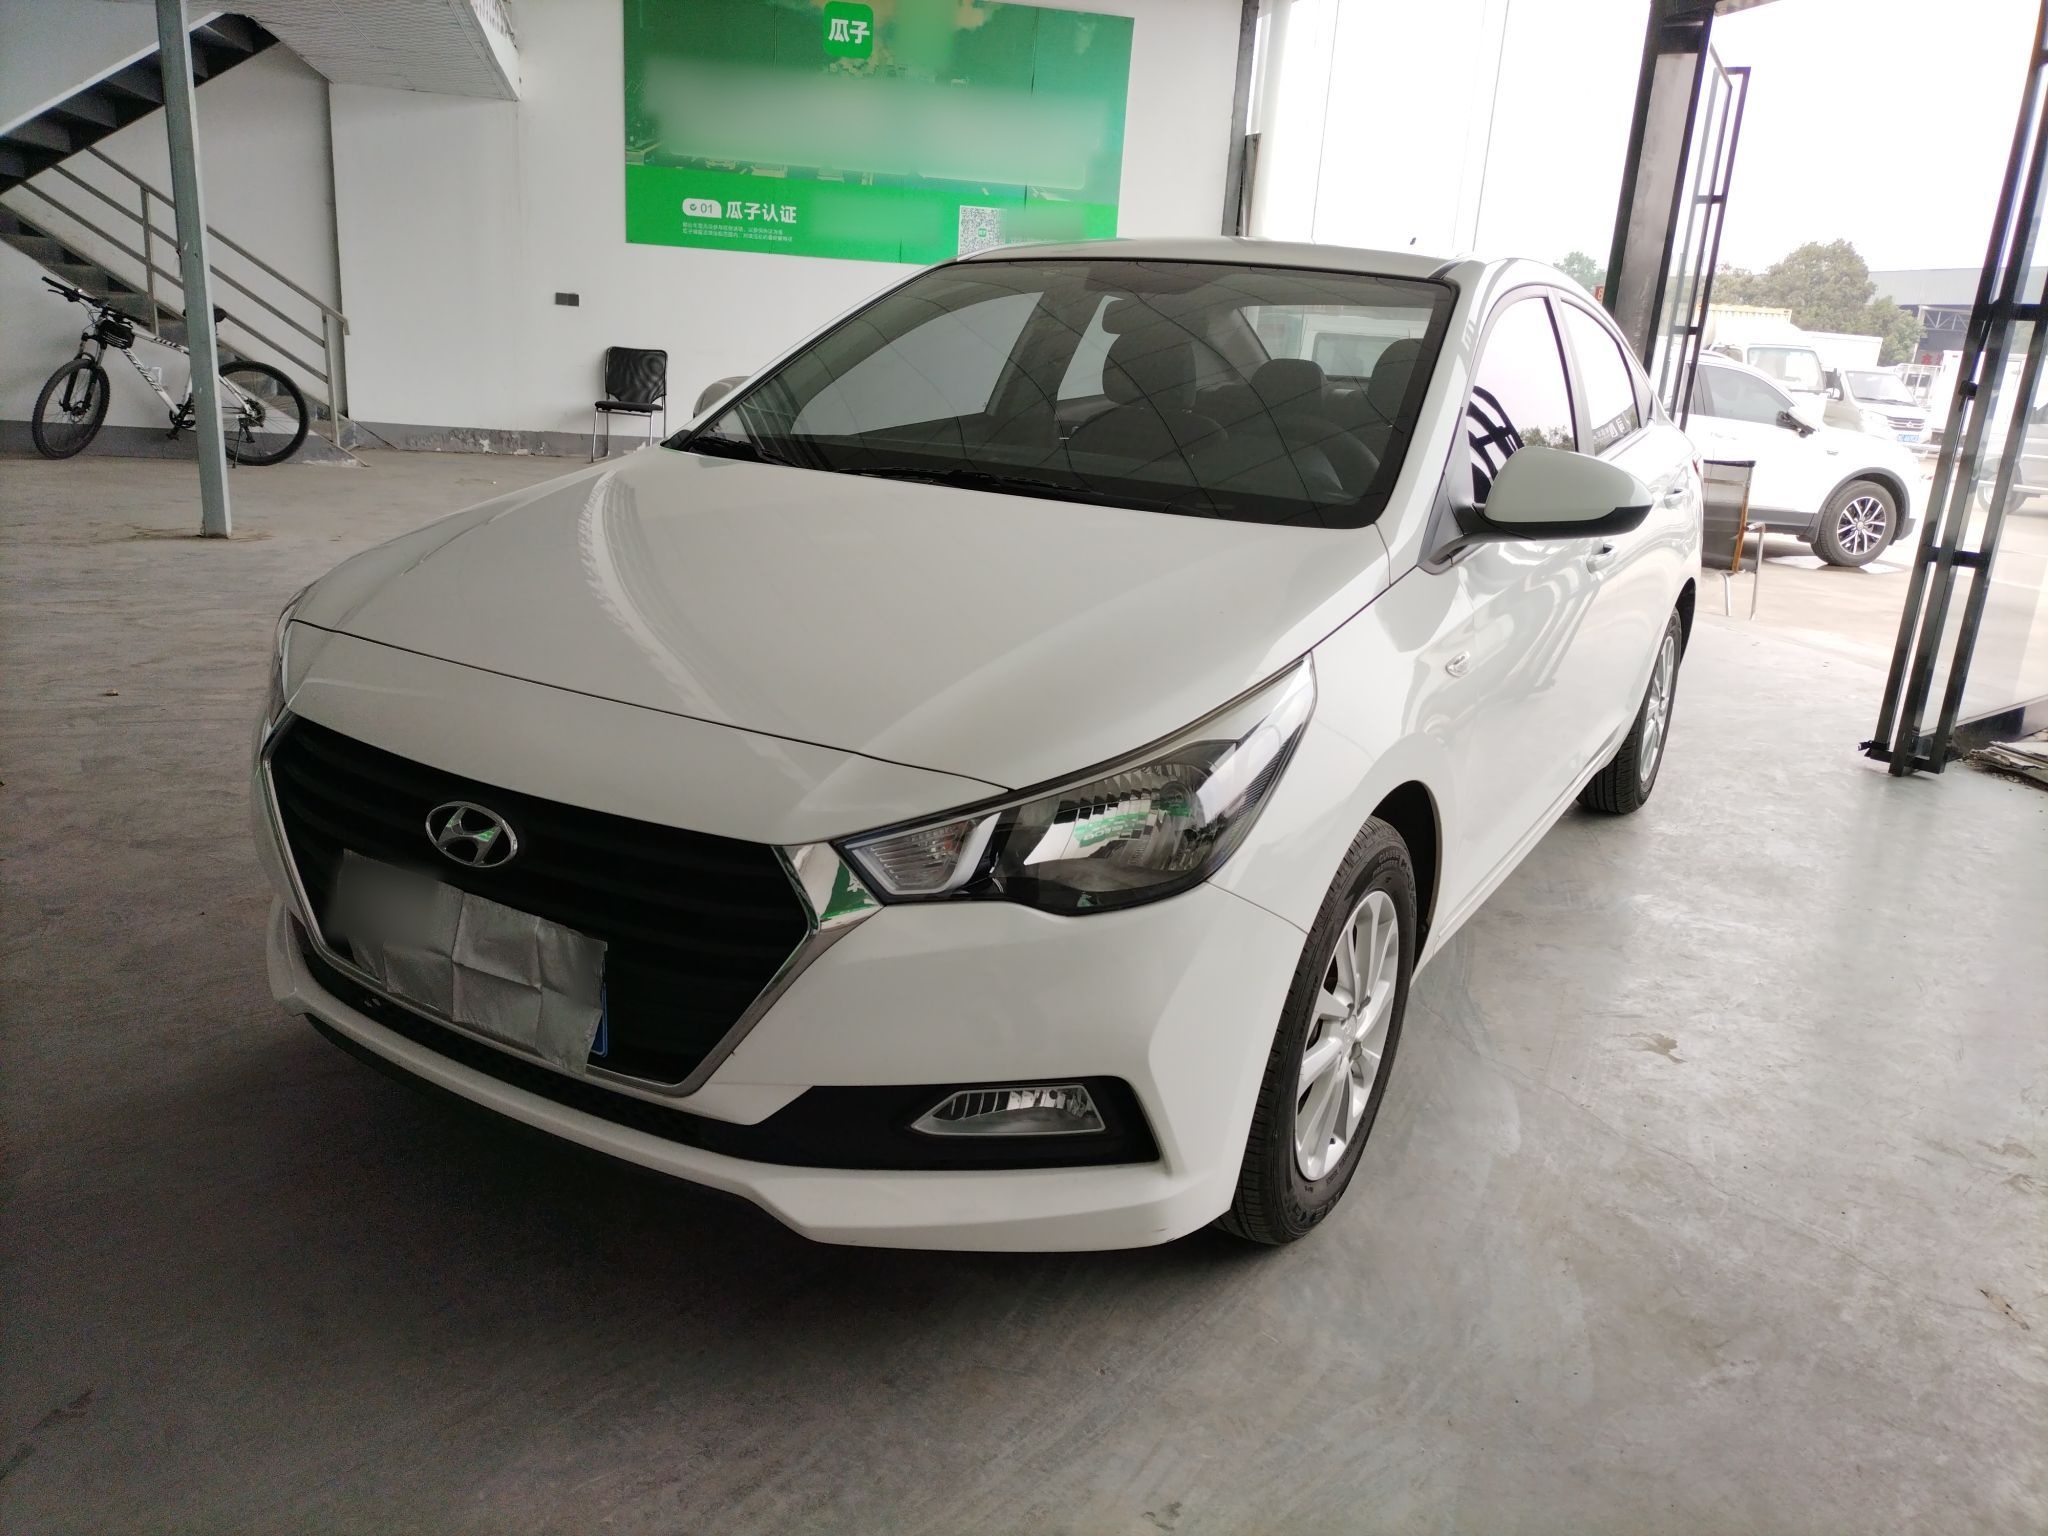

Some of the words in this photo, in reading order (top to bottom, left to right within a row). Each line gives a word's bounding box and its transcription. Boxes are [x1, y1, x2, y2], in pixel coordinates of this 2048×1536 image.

[828, 18, 870, 44] 瓜子
[700, 203, 713, 214] 01
[726, 201, 797, 224] 瓜子认证
